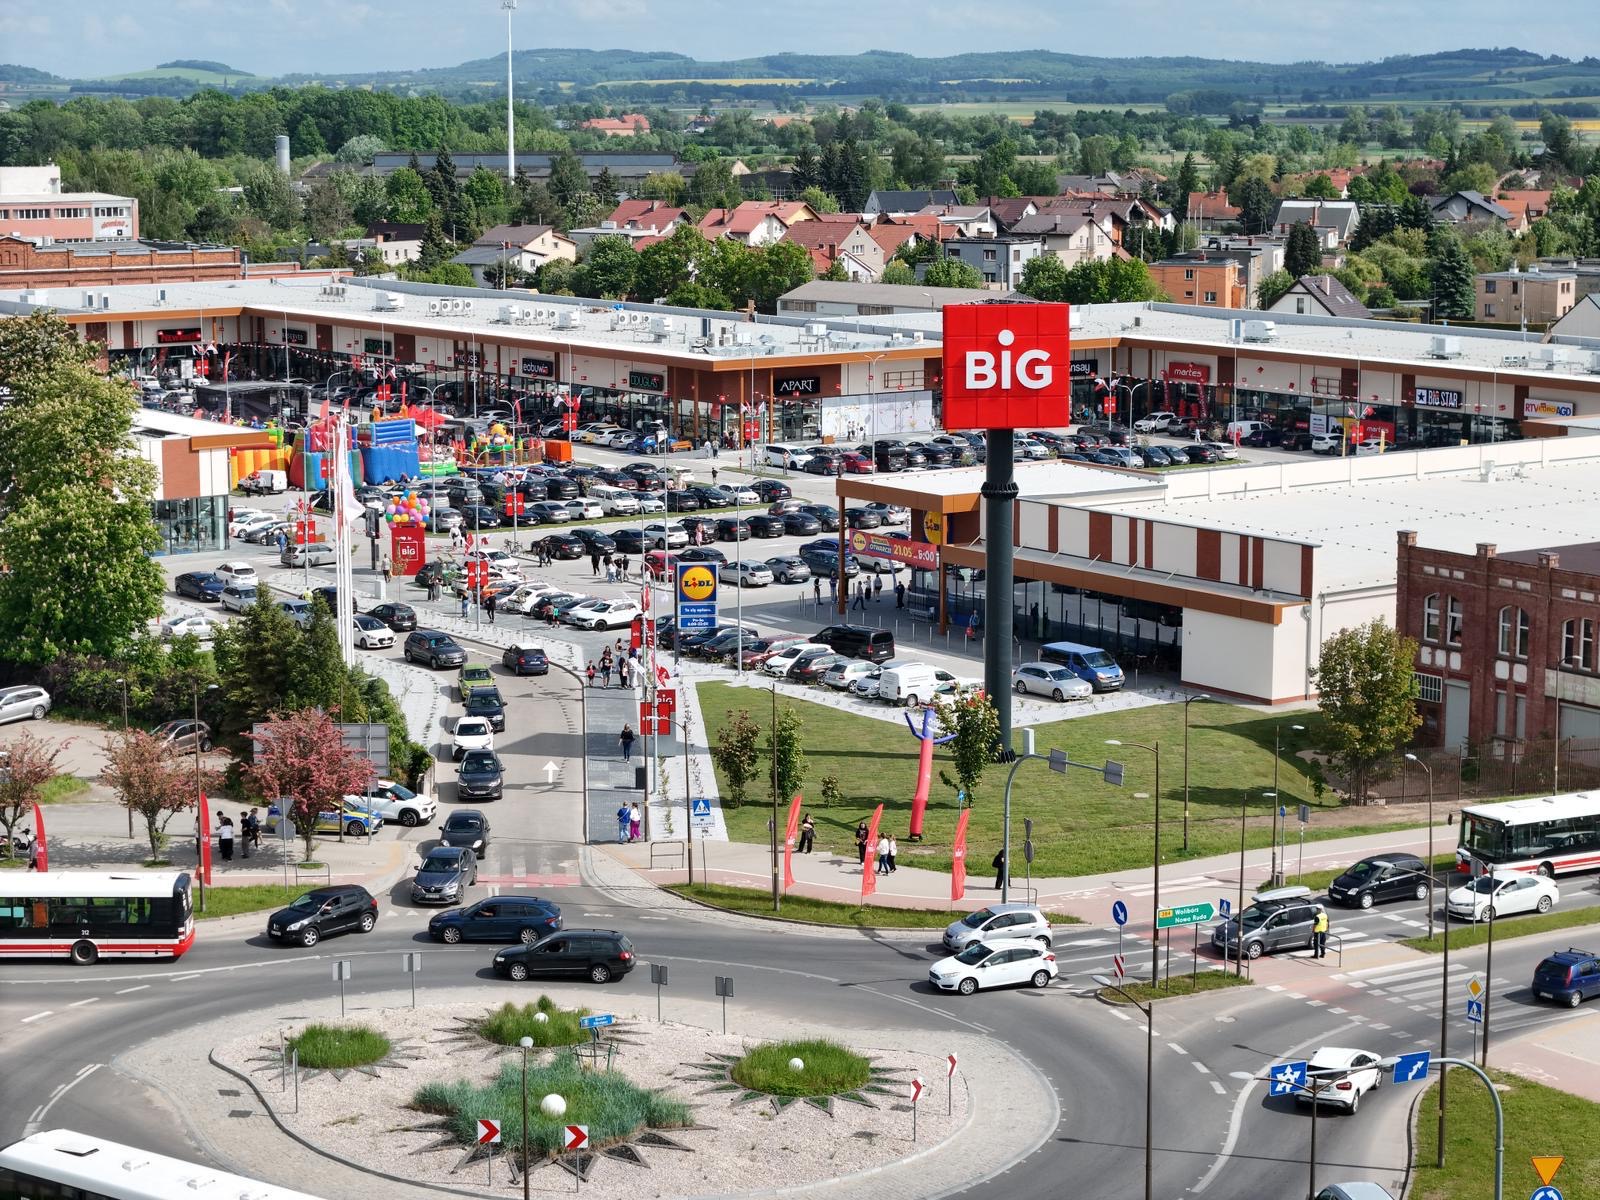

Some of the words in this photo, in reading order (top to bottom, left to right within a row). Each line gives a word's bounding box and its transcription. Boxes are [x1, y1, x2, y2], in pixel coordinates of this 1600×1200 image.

[965, 329, 1053, 390] BiG
[1174, 367, 1203, 378] martes
[630, 375, 659, 389] DOUGLAS
[779, 379, 815, 392] APART
[1440, 391, 1458, 408] STAR
[1525, 402, 1539, 413] RTV
[1556, 405, 1572, 416] AGD
[401, 545, 416, 556] BiG
[893, 543, 913, 557] 21.05
